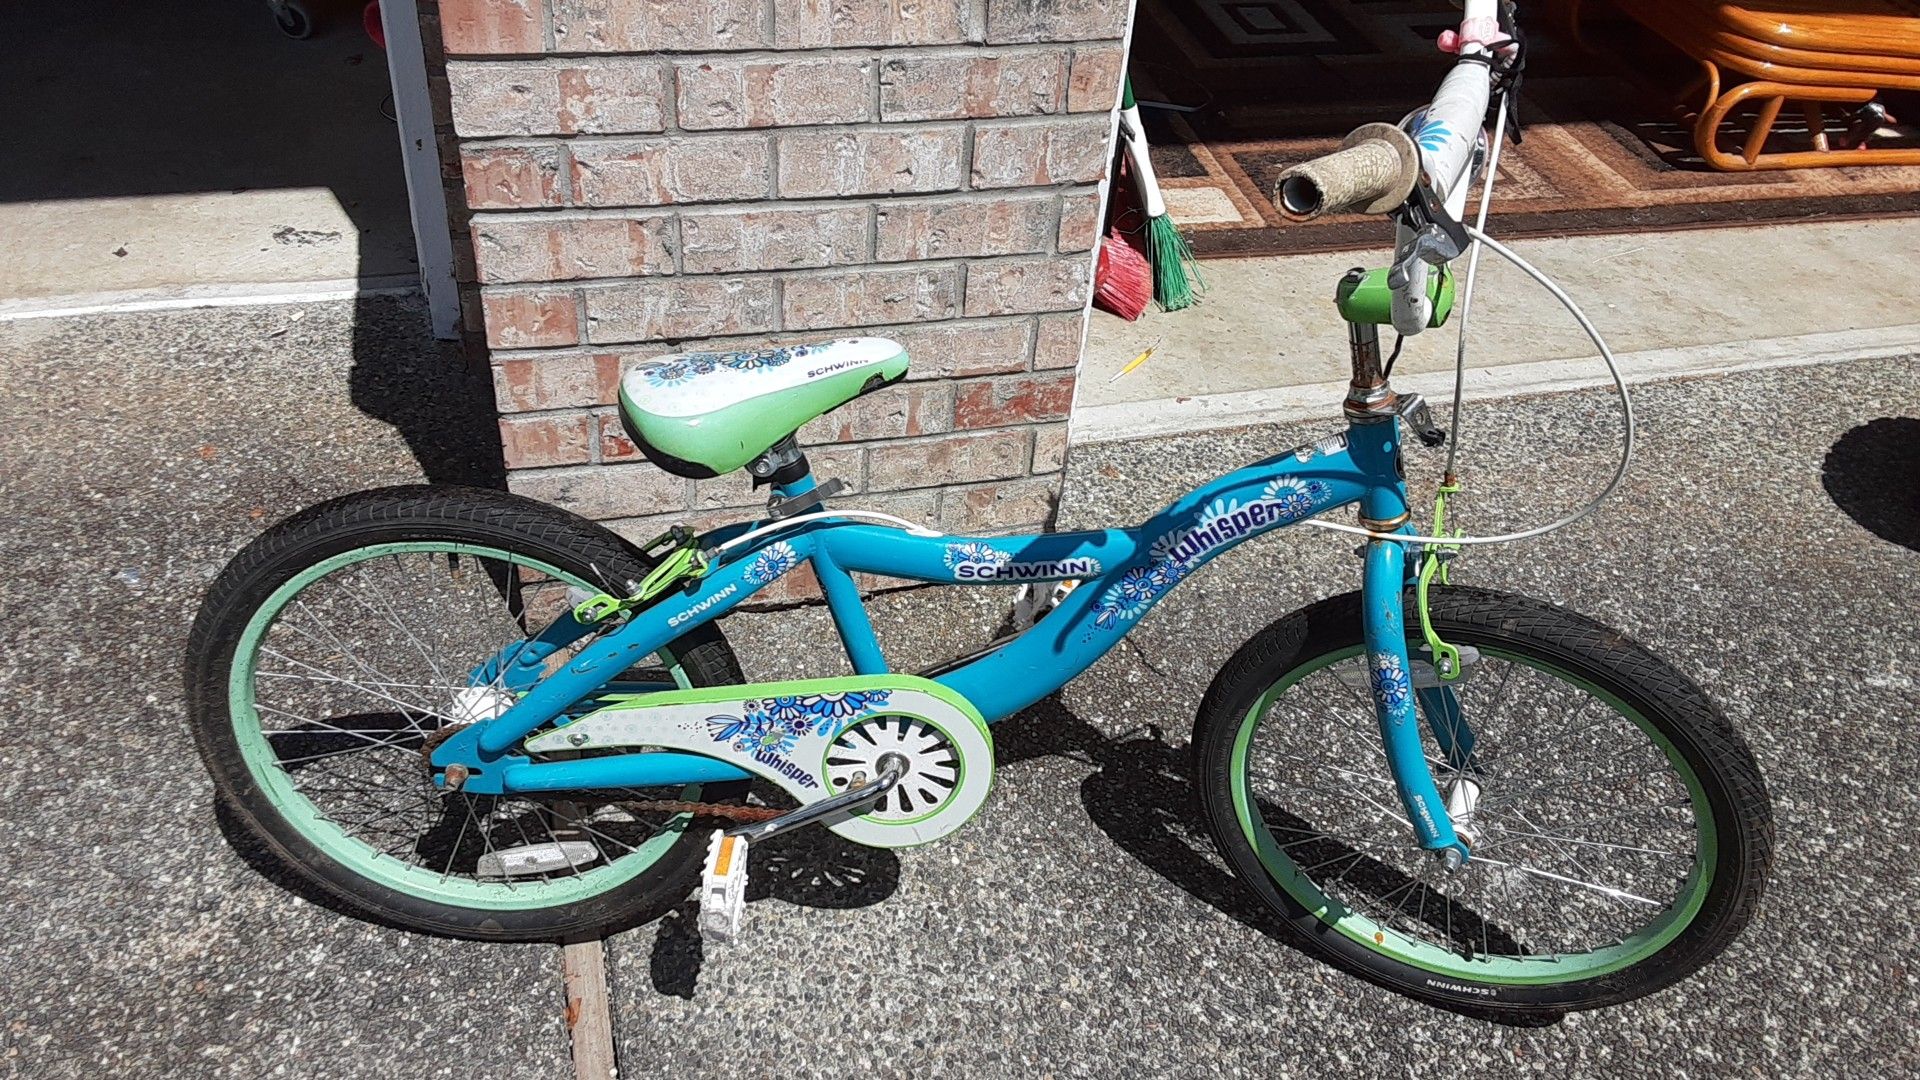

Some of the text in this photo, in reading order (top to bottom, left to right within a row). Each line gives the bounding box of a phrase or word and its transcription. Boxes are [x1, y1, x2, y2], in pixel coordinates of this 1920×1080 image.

[958, 561, 1087, 579] SCHWINN
[667, 583, 738, 628] SCHWINN
[1413, 795, 1440, 838] SCHWINN
[1426, 979, 1490, 995] SCHWINN
